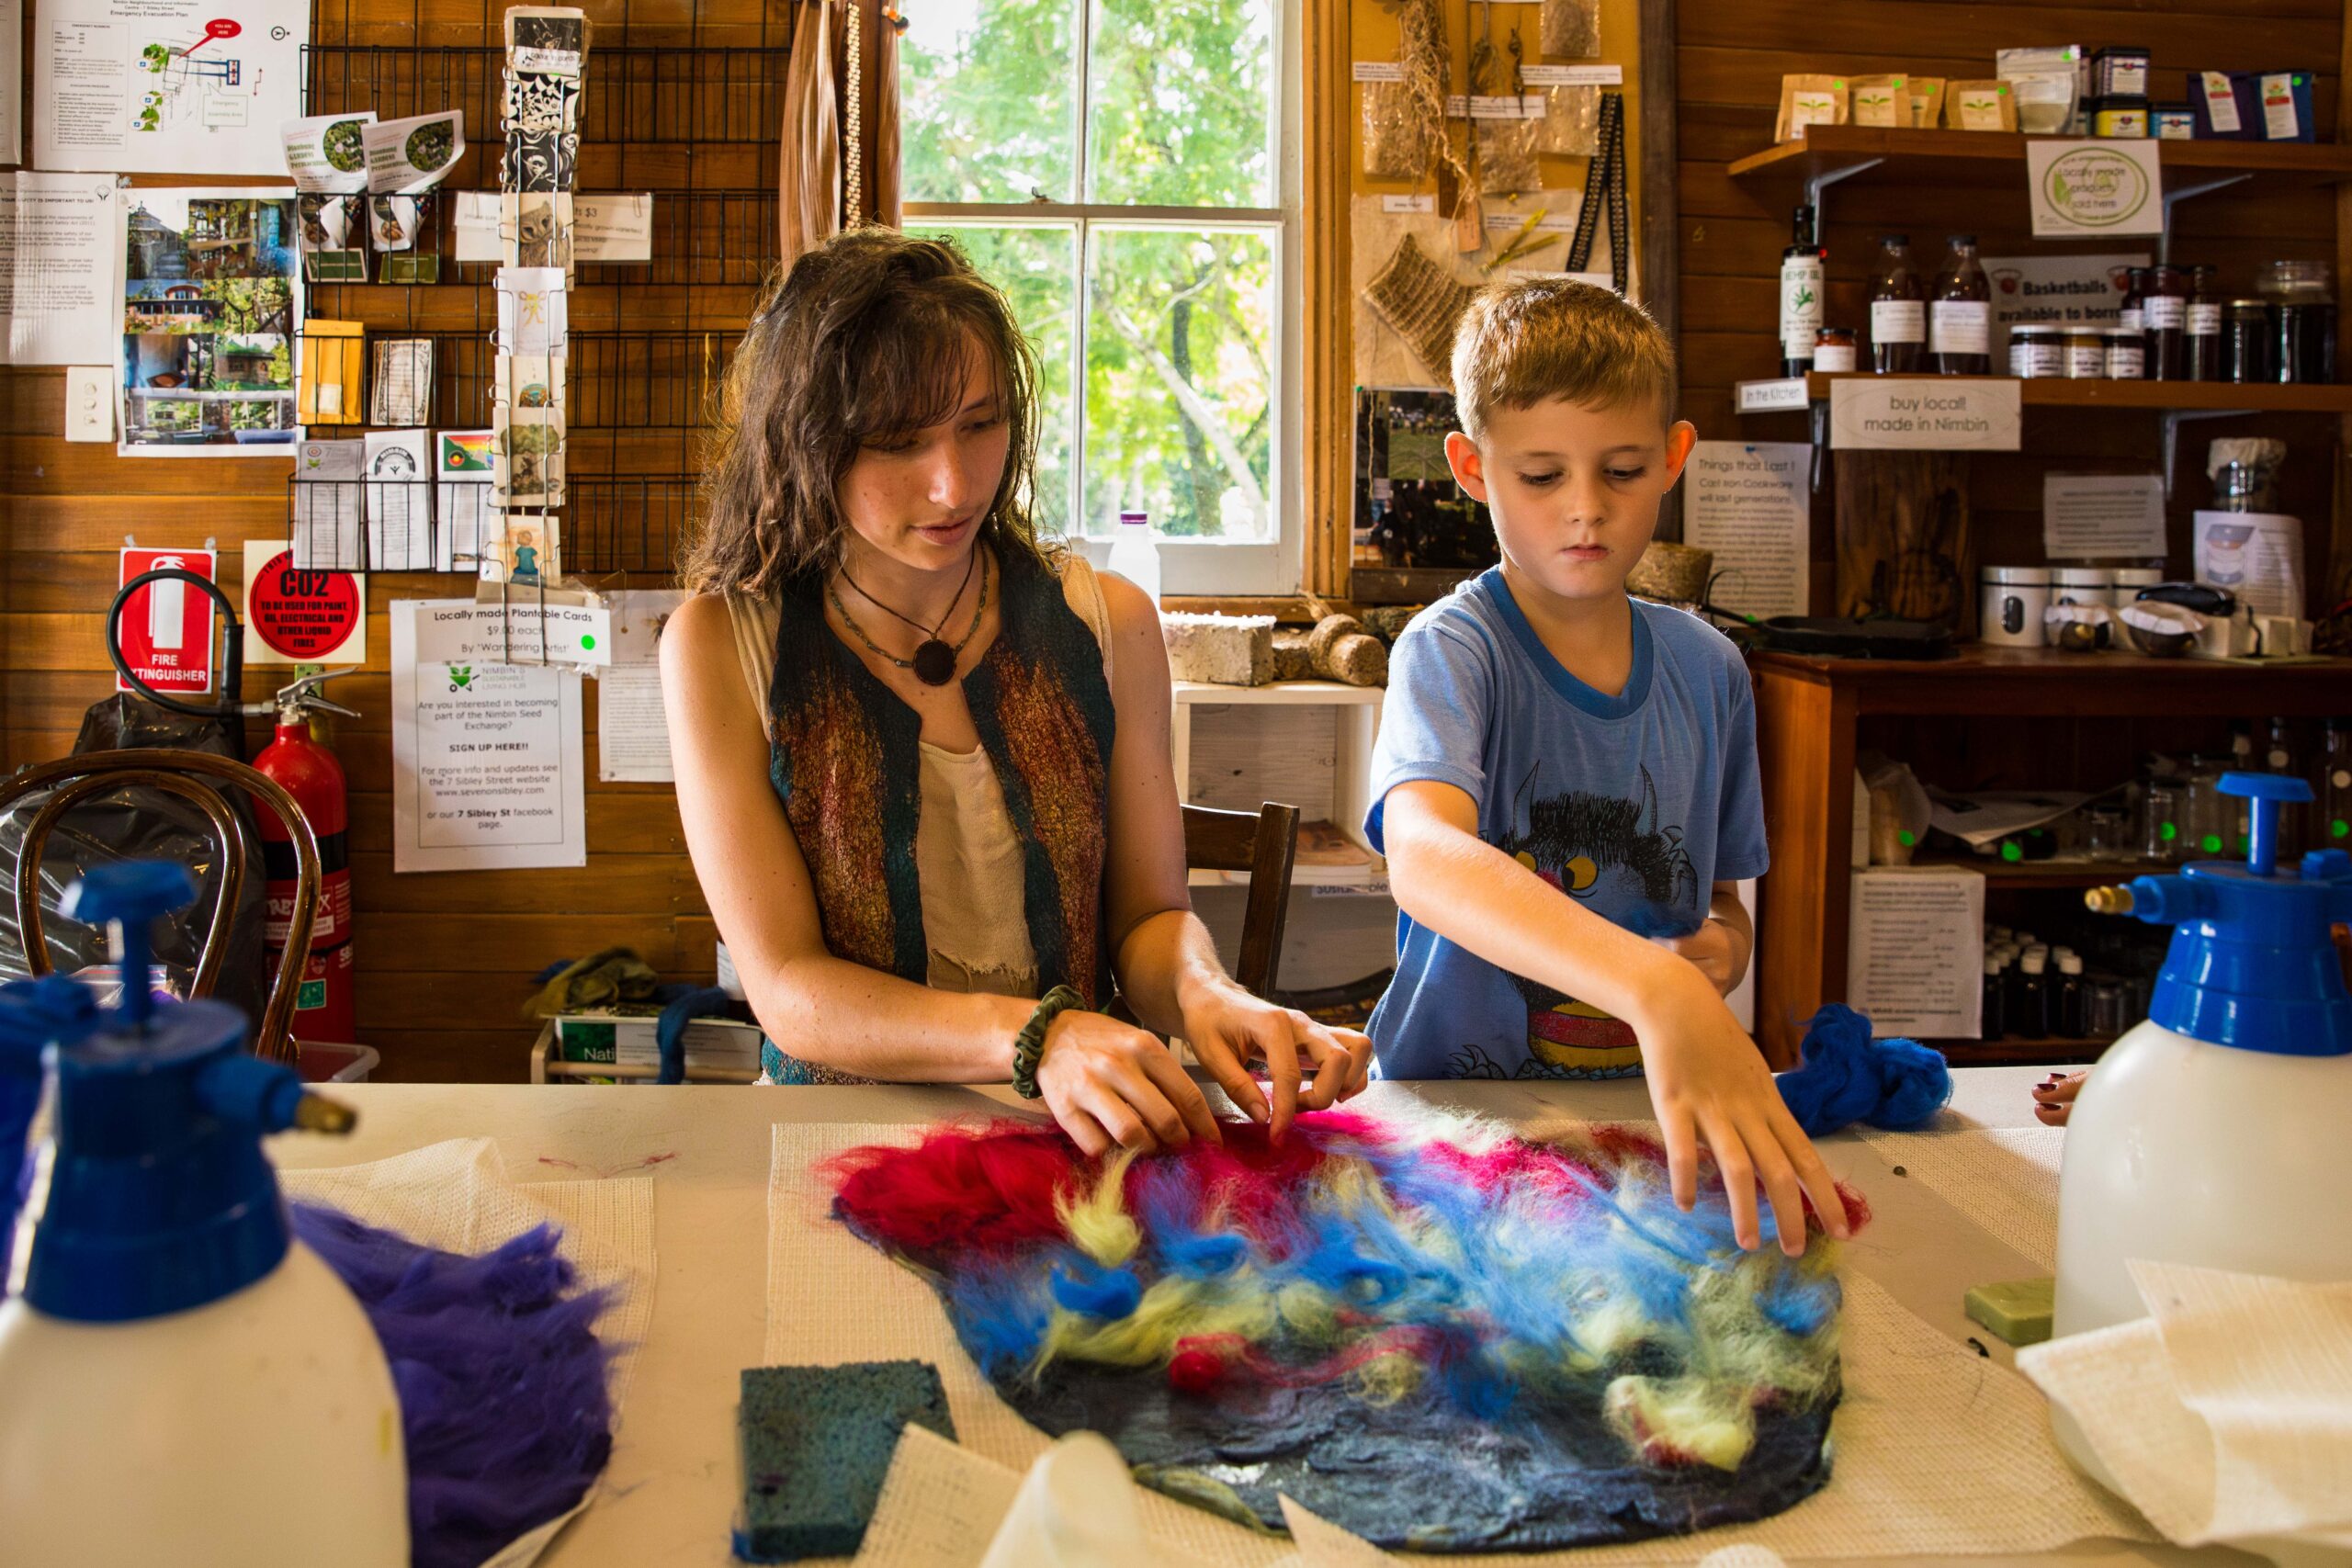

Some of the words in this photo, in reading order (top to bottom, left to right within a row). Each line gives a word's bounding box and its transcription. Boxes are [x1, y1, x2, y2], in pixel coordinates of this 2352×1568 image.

[585, 207, 597, 218] $3
[2023, 279, 2108, 296] Basketballs
[1997, 306, 2063, 322] available
[2065, 306, 2081, 320] to
[1890, 395, 1920, 412] buy
[1864, 417, 1913, 432] made
[1917, 416, 1931, 432] in
[1935, 416, 1990, 432] Nimbin
[1698, 458, 1735, 473] Things
[1736, 459, 1762, 471] that
[1699, 478, 1722, 488] Cast
[1715, 493, 1732, 502] last
[261, 601, 272, 611] TO
[273, 601, 283, 611] BE
[284, 601, 305, 611] USED
[307, 601, 322, 611] FOR
[280, 614, 326, 624] ELECTRICAL
[328, 614, 345, 624] AND
[434, 609, 473, 622] Locally
[512, 608, 560, 620] Plantable
[563, 610, 593, 623] Cards
[277, 626, 303, 636] OTHER
[305, 626, 332, 636] LIQUID
[517, 625, 543, 636] each
[461, 643, 474, 654] By
[152, 654, 178, 666] FIRE
[131, 668, 206, 682] TINGUISHER
[418, 702, 434, 710] Are
[435, 701, 453, 710] you
[455, 699, 501, 709] interested
[503, 699, 512, 707] in
[514, 698, 559, 708] becoming
[435, 711, 453, 721] part
[456, 710, 466, 719] of
[467, 710, 482, 719] the
[485, 710, 516, 718] Nimbin
[519, 709, 542, 717] Seed
[465, 721, 514, 732] Exchange?
[448, 743, 475, 752] SIGN
[478, 743, 492, 751] UP
[495, 742, 529, 751] HERE!!
[421, 766, 435, 774] For
[438, 766, 462, 774] more
[464, 765, 481, 773] info
[484, 765, 501, 773] and
[503, 764, 541, 775] updates
[542, 764, 559, 773] see
[429, 778, 444, 786] the
[447, 777, 453, 785] 7
[455, 776, 482, 786] Sibley
[485, 776, 514, 784] Street
[515, 775, 551, 784] website
[435, 786, 545, 796] www.sevenonsibley.com
[426, 811, 436, 819] or
[458, 809, 464, 818] 7
[466, 808, 498, 819] Sibley
[500, 808, 511, 817] St
[513, 807, 553, 816] facebook
[478, 820, 503, 831] page.
[584, 1047, 616, 1061] Nati
